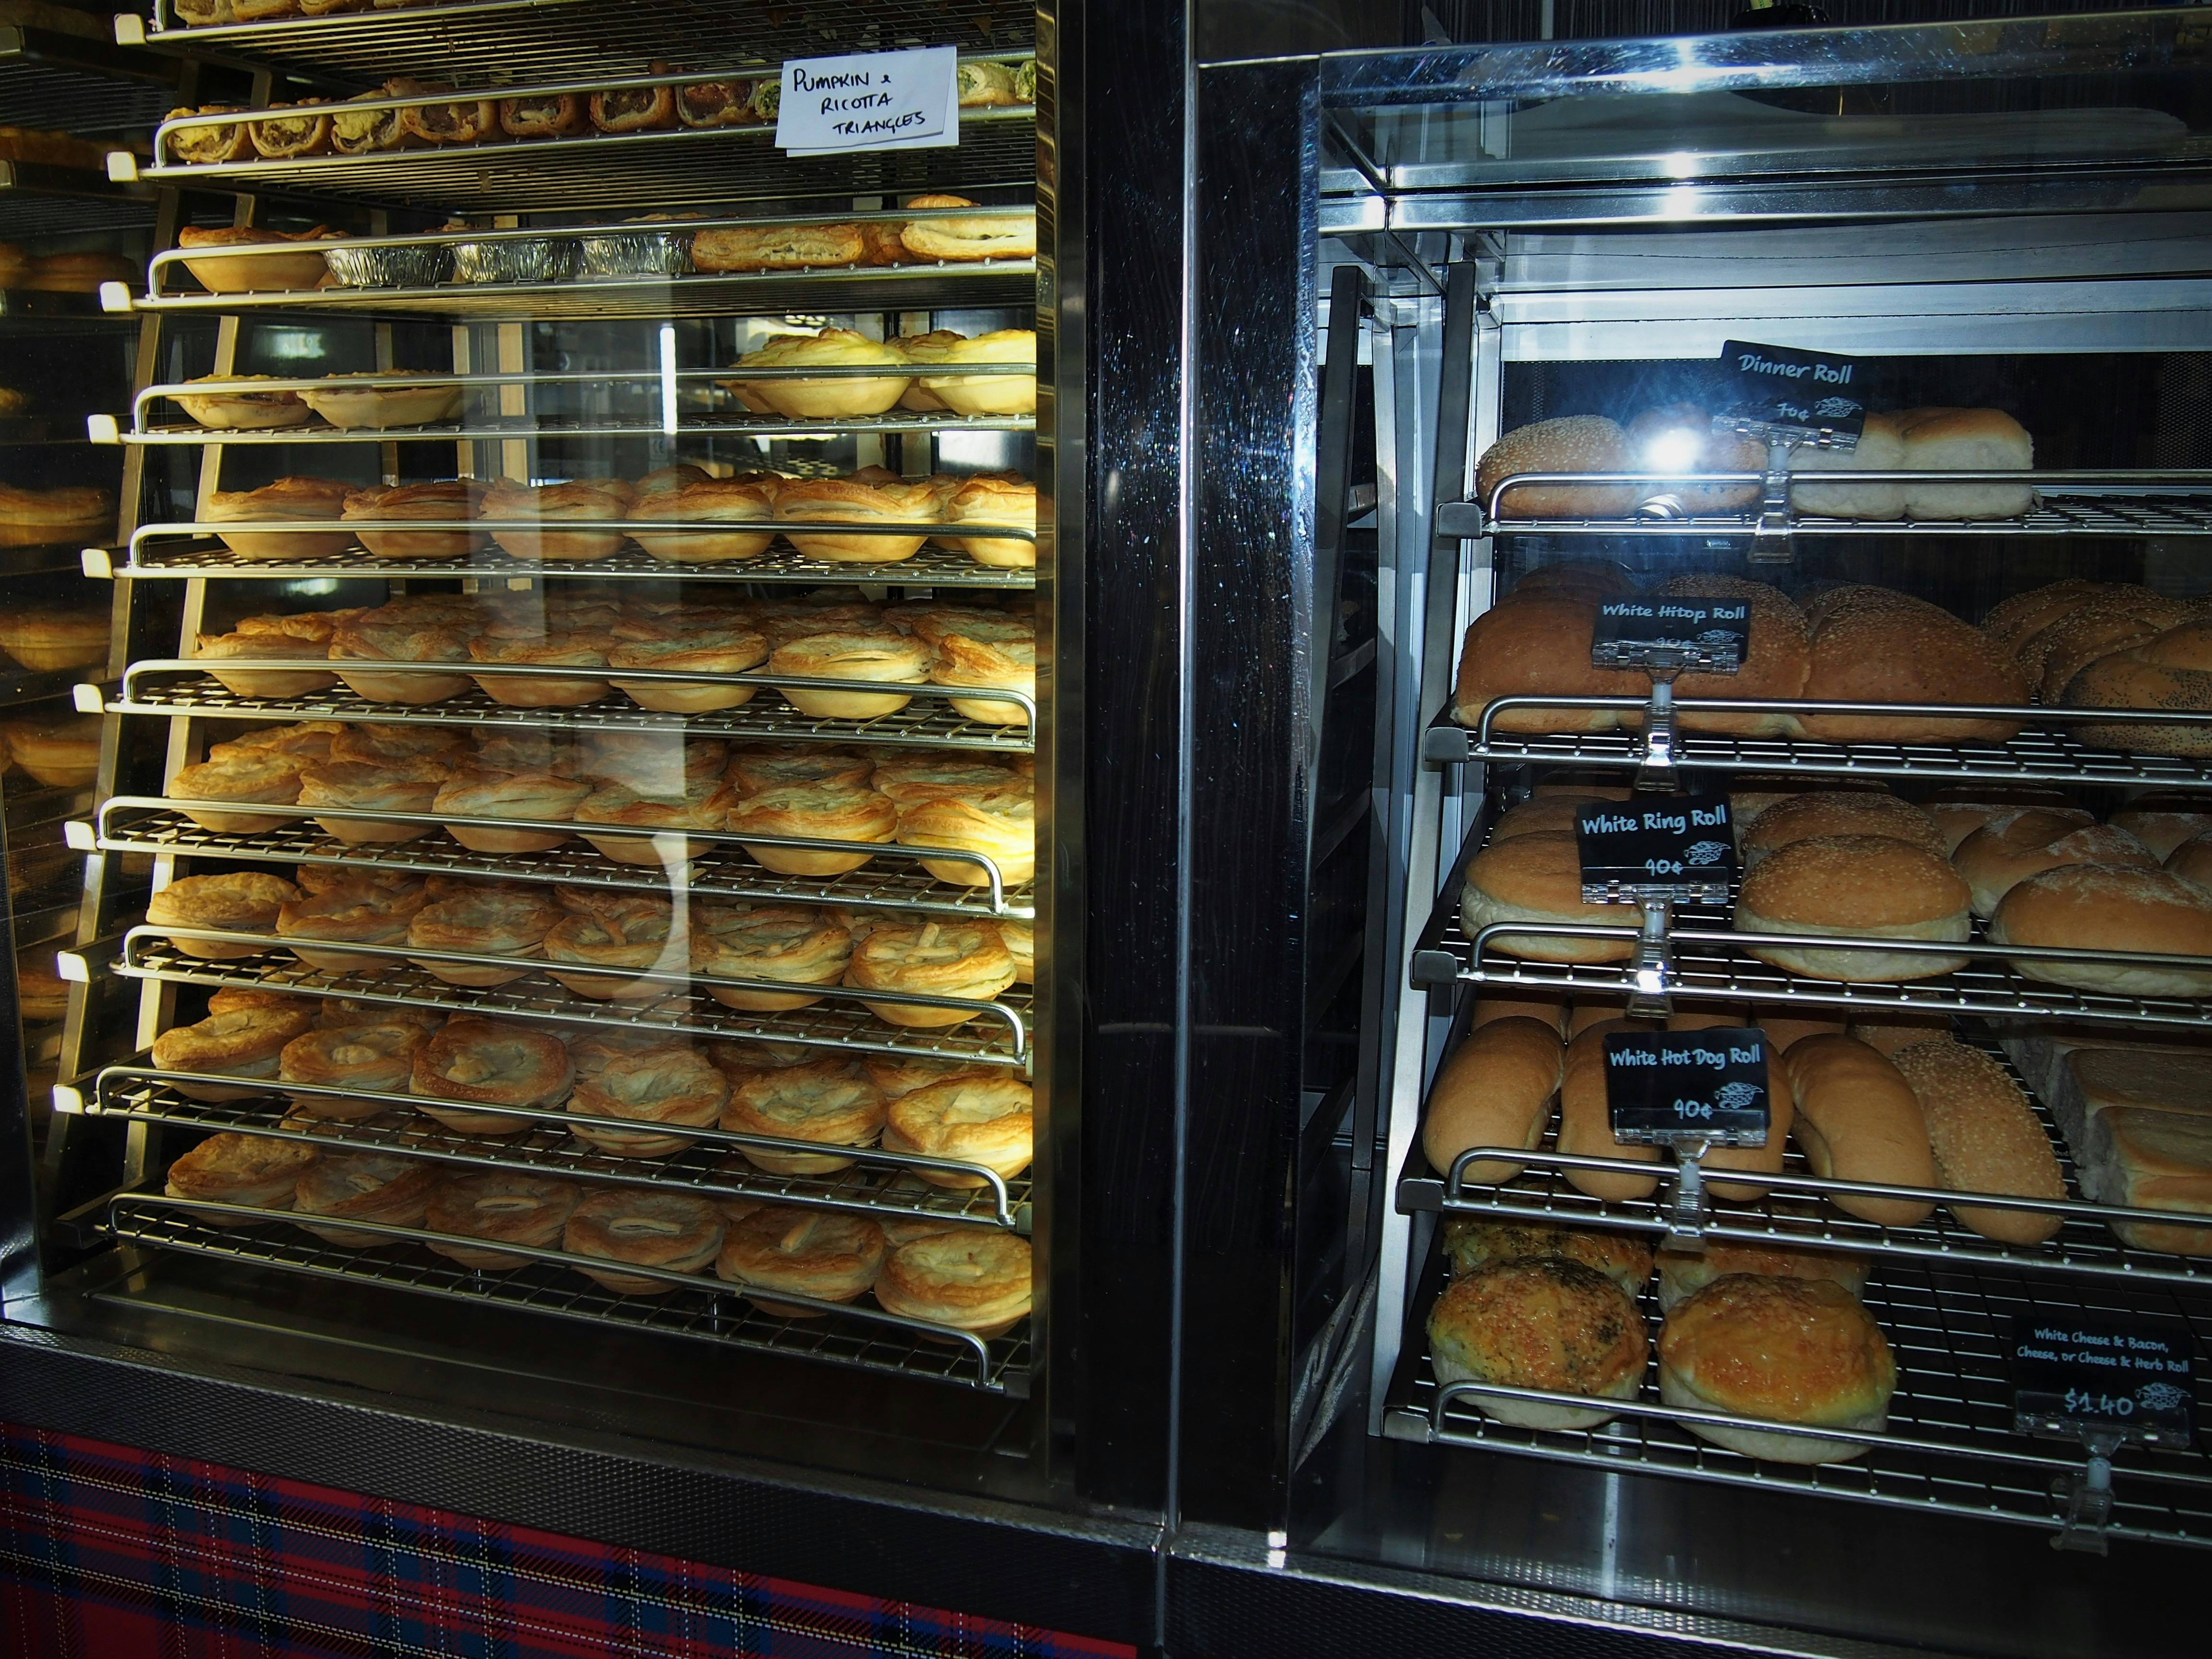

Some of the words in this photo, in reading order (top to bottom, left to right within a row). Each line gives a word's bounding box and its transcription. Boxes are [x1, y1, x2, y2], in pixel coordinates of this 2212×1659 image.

[793, 68, 869, 92] PUMPKIN
[820, 92, 893, 115] RICOTTA
[832, 111, 926, 134] TRIANGLES
[1738, 354, 1811, 379] Dinner
[1813, 364, 1852, 384] Roll
[1602, 603, 1653, 617] White
[1658, 605, 1707, 624] Hitop
[1713, 605, 1745, 620] Roll
[1582, 814, 1639, 835] White
[1643, 812, 1686, 834] Ring
[1690, 804, 1727, 827] Roll
[1645, 859, 1684, 877] 90¢
[1610, 1048, 1658, 1066] White
[1661, 1048, 1692, 1066] Hot
[1692, 1048, 1726, 1070] Dog
[1729, 1044, 1761, 1064] Roll
[1673, 1098, 1714, 1120] 90¢
[2034, 1328, 2069, 1342] White
[2072, 1331, 2110, 1346] Cheese
[2113, 1335, 2124, 1347] &
[2128, 1337, 2169, 1354] Bacon,
[2017, 1346, 2058, 1362] Cheese,
[2061, 1353, 2075, 1361] or
[2078, 1352, 2117, 1367] Cheese
[2120, 1357, 2131, 1368] &
[2134, 1357, 2163, 1371] Herb
[2167, 1360, 2189, 1373] Roll
[2065, 1387, 2134, 1416] $1.40
